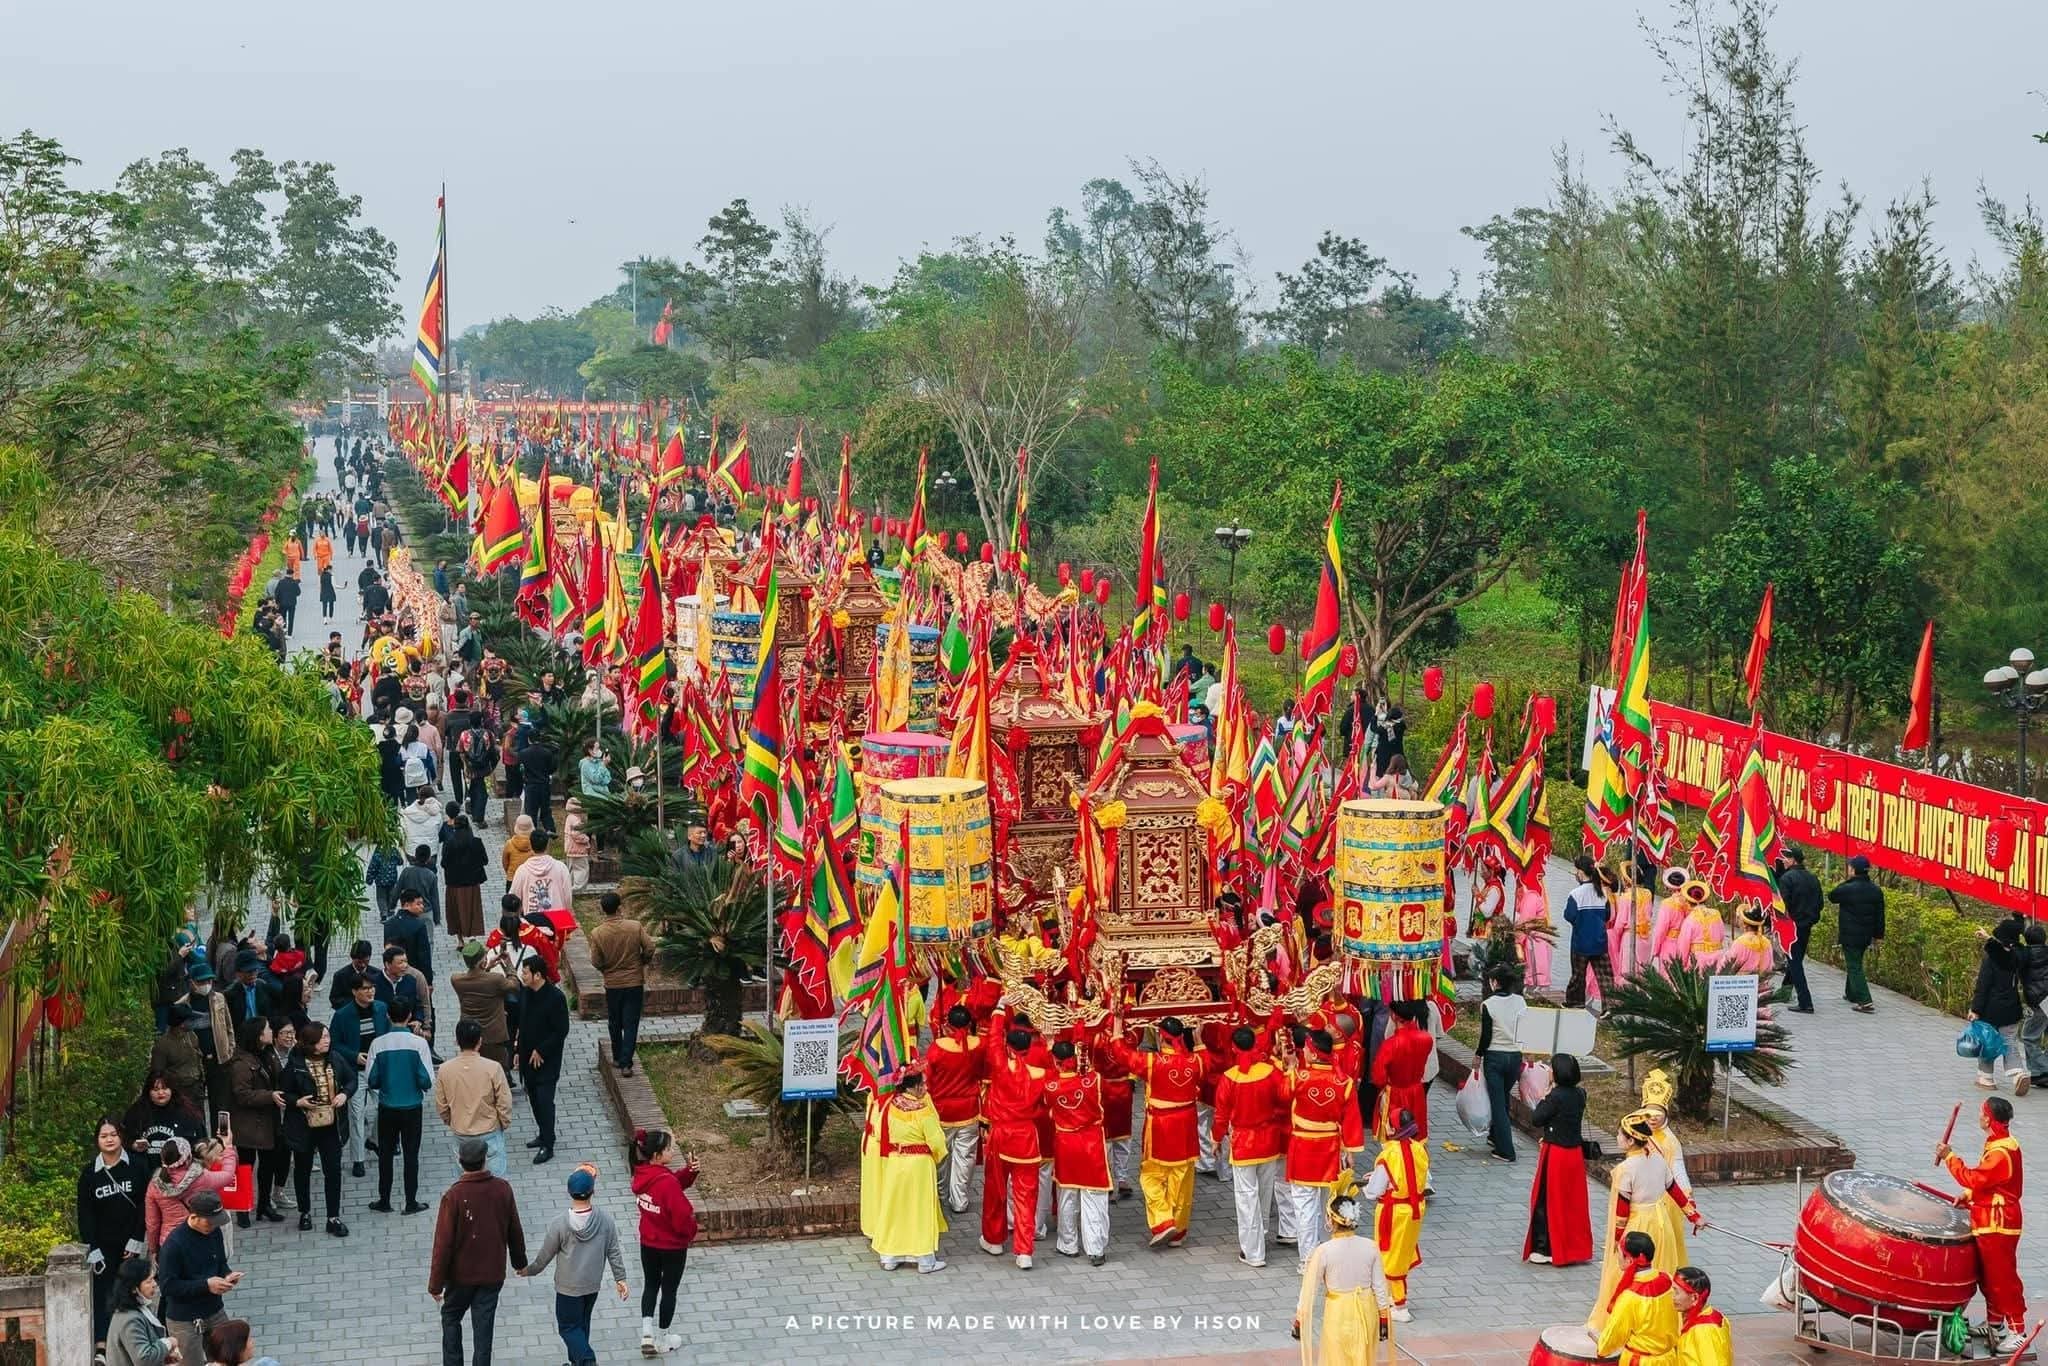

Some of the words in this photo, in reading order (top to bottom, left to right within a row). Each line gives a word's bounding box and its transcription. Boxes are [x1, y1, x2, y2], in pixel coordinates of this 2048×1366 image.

[1782, 756, 1806, 821] CÁC
[1918, 798, 1965, 880] HUYỆN
[95, 1180, 132, 1199] CELINE
